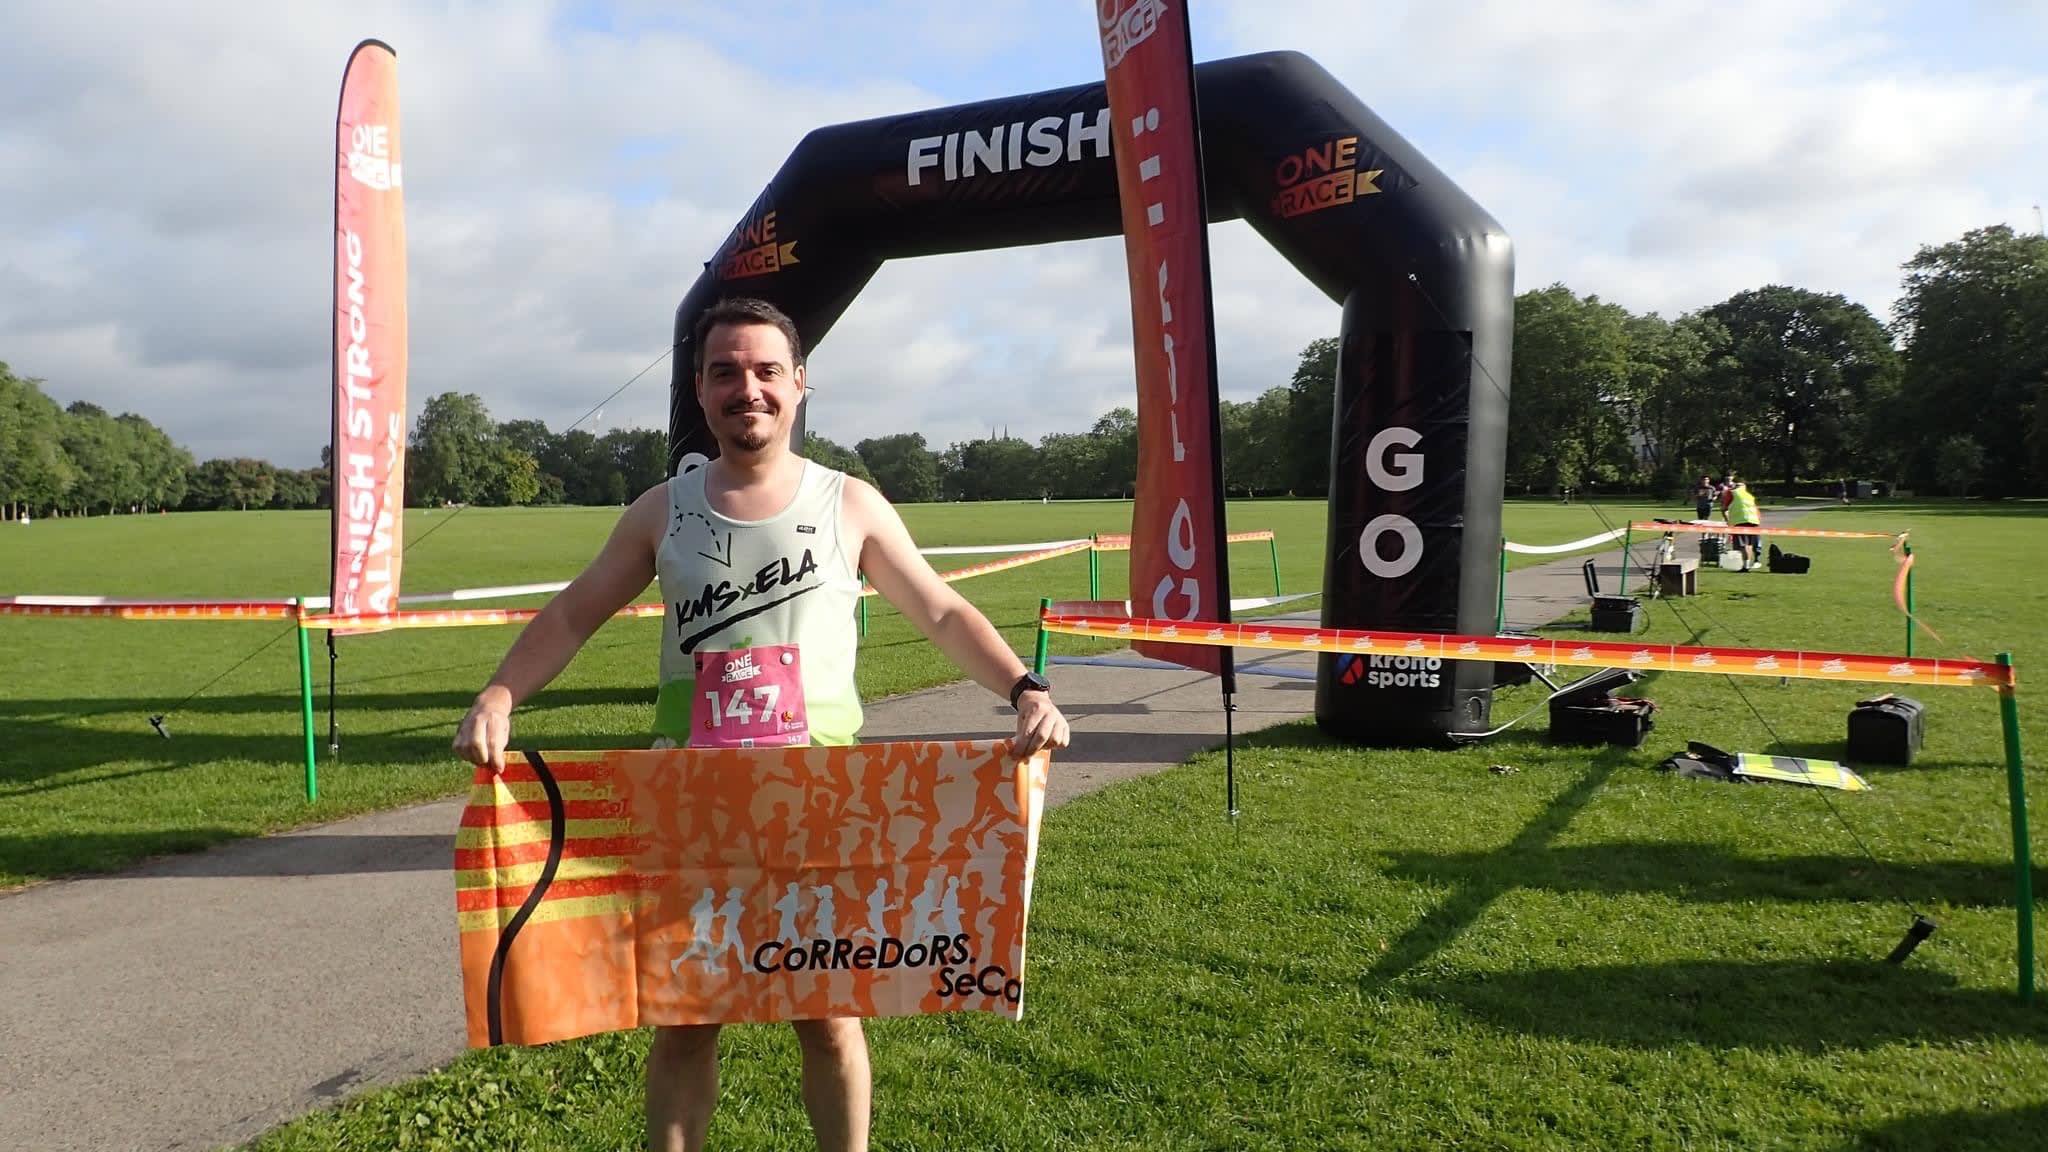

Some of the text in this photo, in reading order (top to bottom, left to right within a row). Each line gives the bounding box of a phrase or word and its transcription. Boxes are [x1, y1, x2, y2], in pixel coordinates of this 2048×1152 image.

[907, 107, 1112, 187] FINISH
[1276, 137, 1358, 187] ONE
[1281, 172, 1352, 214] RACE
[346, 230, 374, 440] STRONG
[1359, 427, 1425, 579] GO
[725, 654, 752, 672] ONE
[1368, 671, 1440, 689] sports
[705, 685, 779, 727] 147
